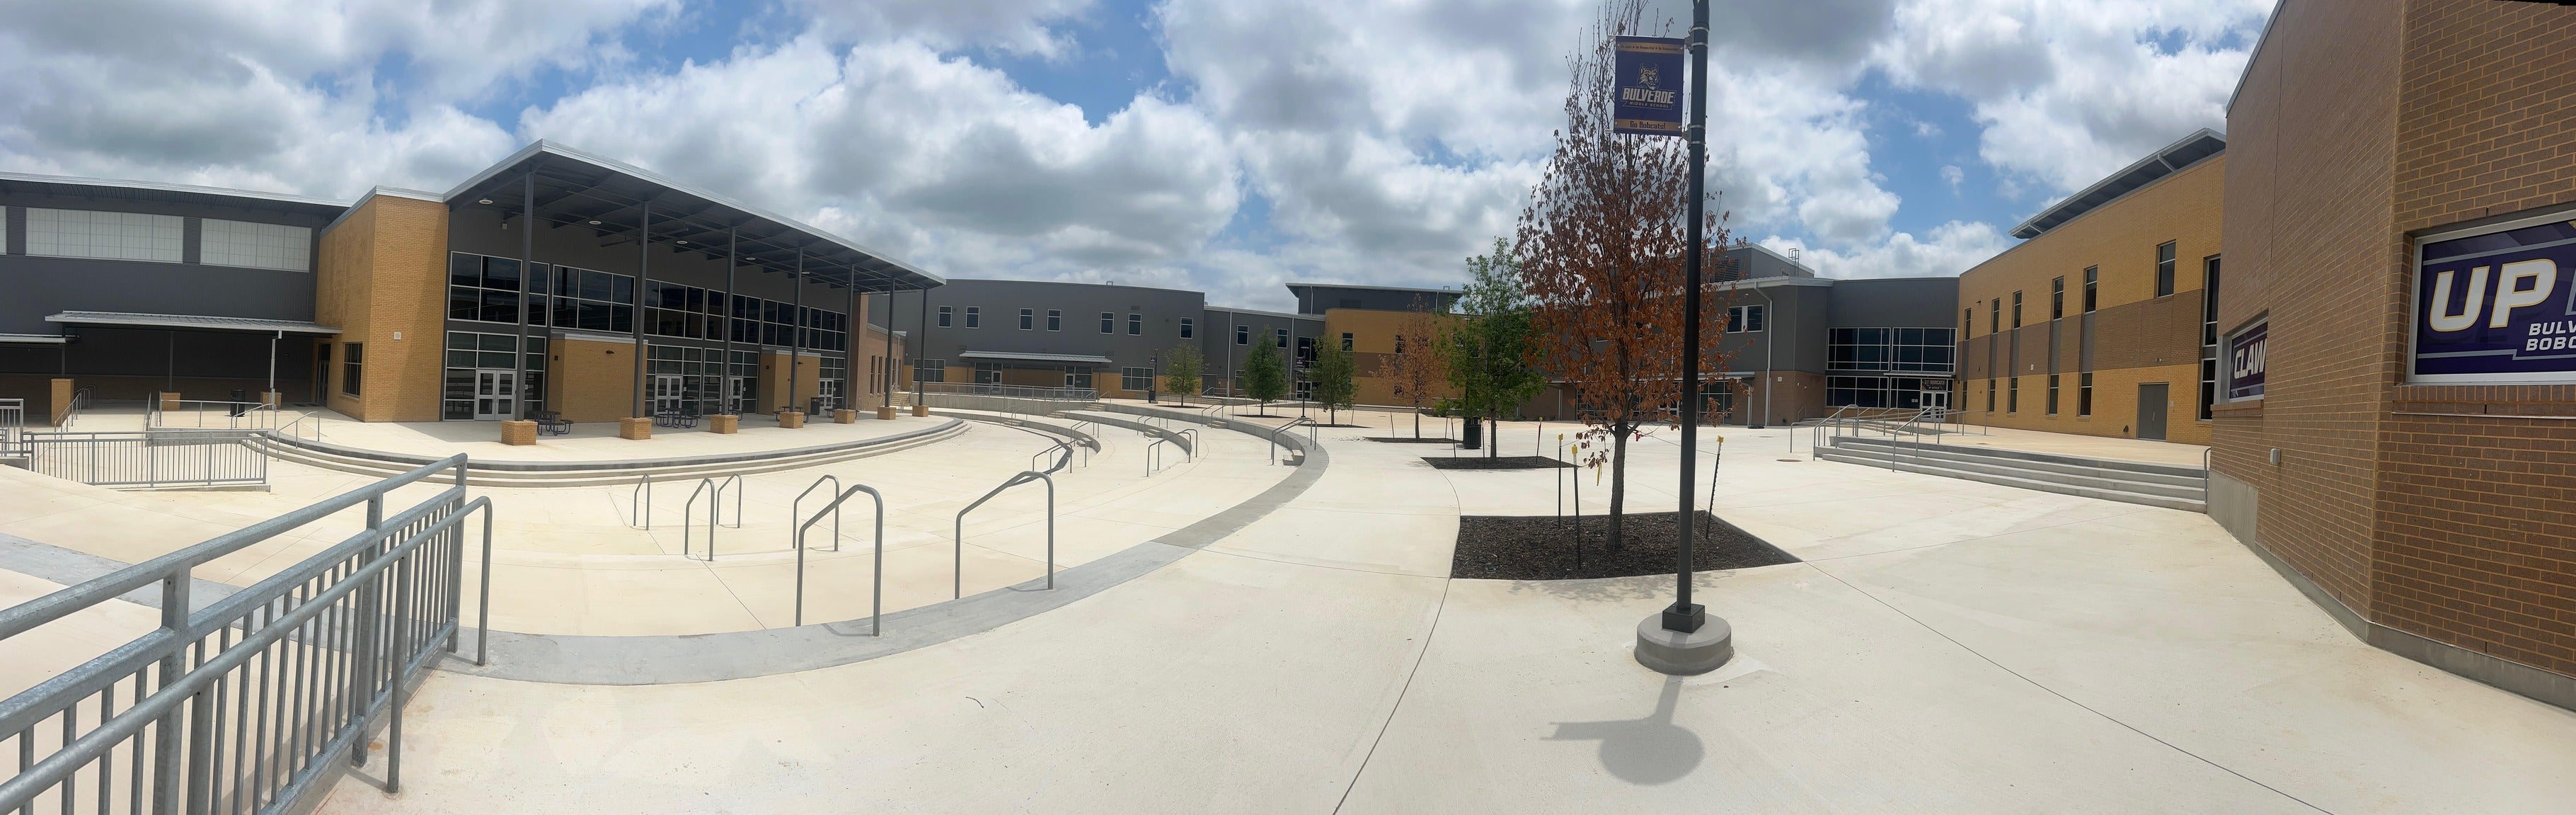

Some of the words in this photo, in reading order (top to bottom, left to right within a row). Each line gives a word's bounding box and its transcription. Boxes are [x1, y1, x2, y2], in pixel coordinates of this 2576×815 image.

[1622, 88, 1675, 104] BULVERDE
[1639, 121, 1666, 130] Bobcats!
[2429, 258, 2557, 332] UP
[2234, 338, 2267, 379] CLAW
